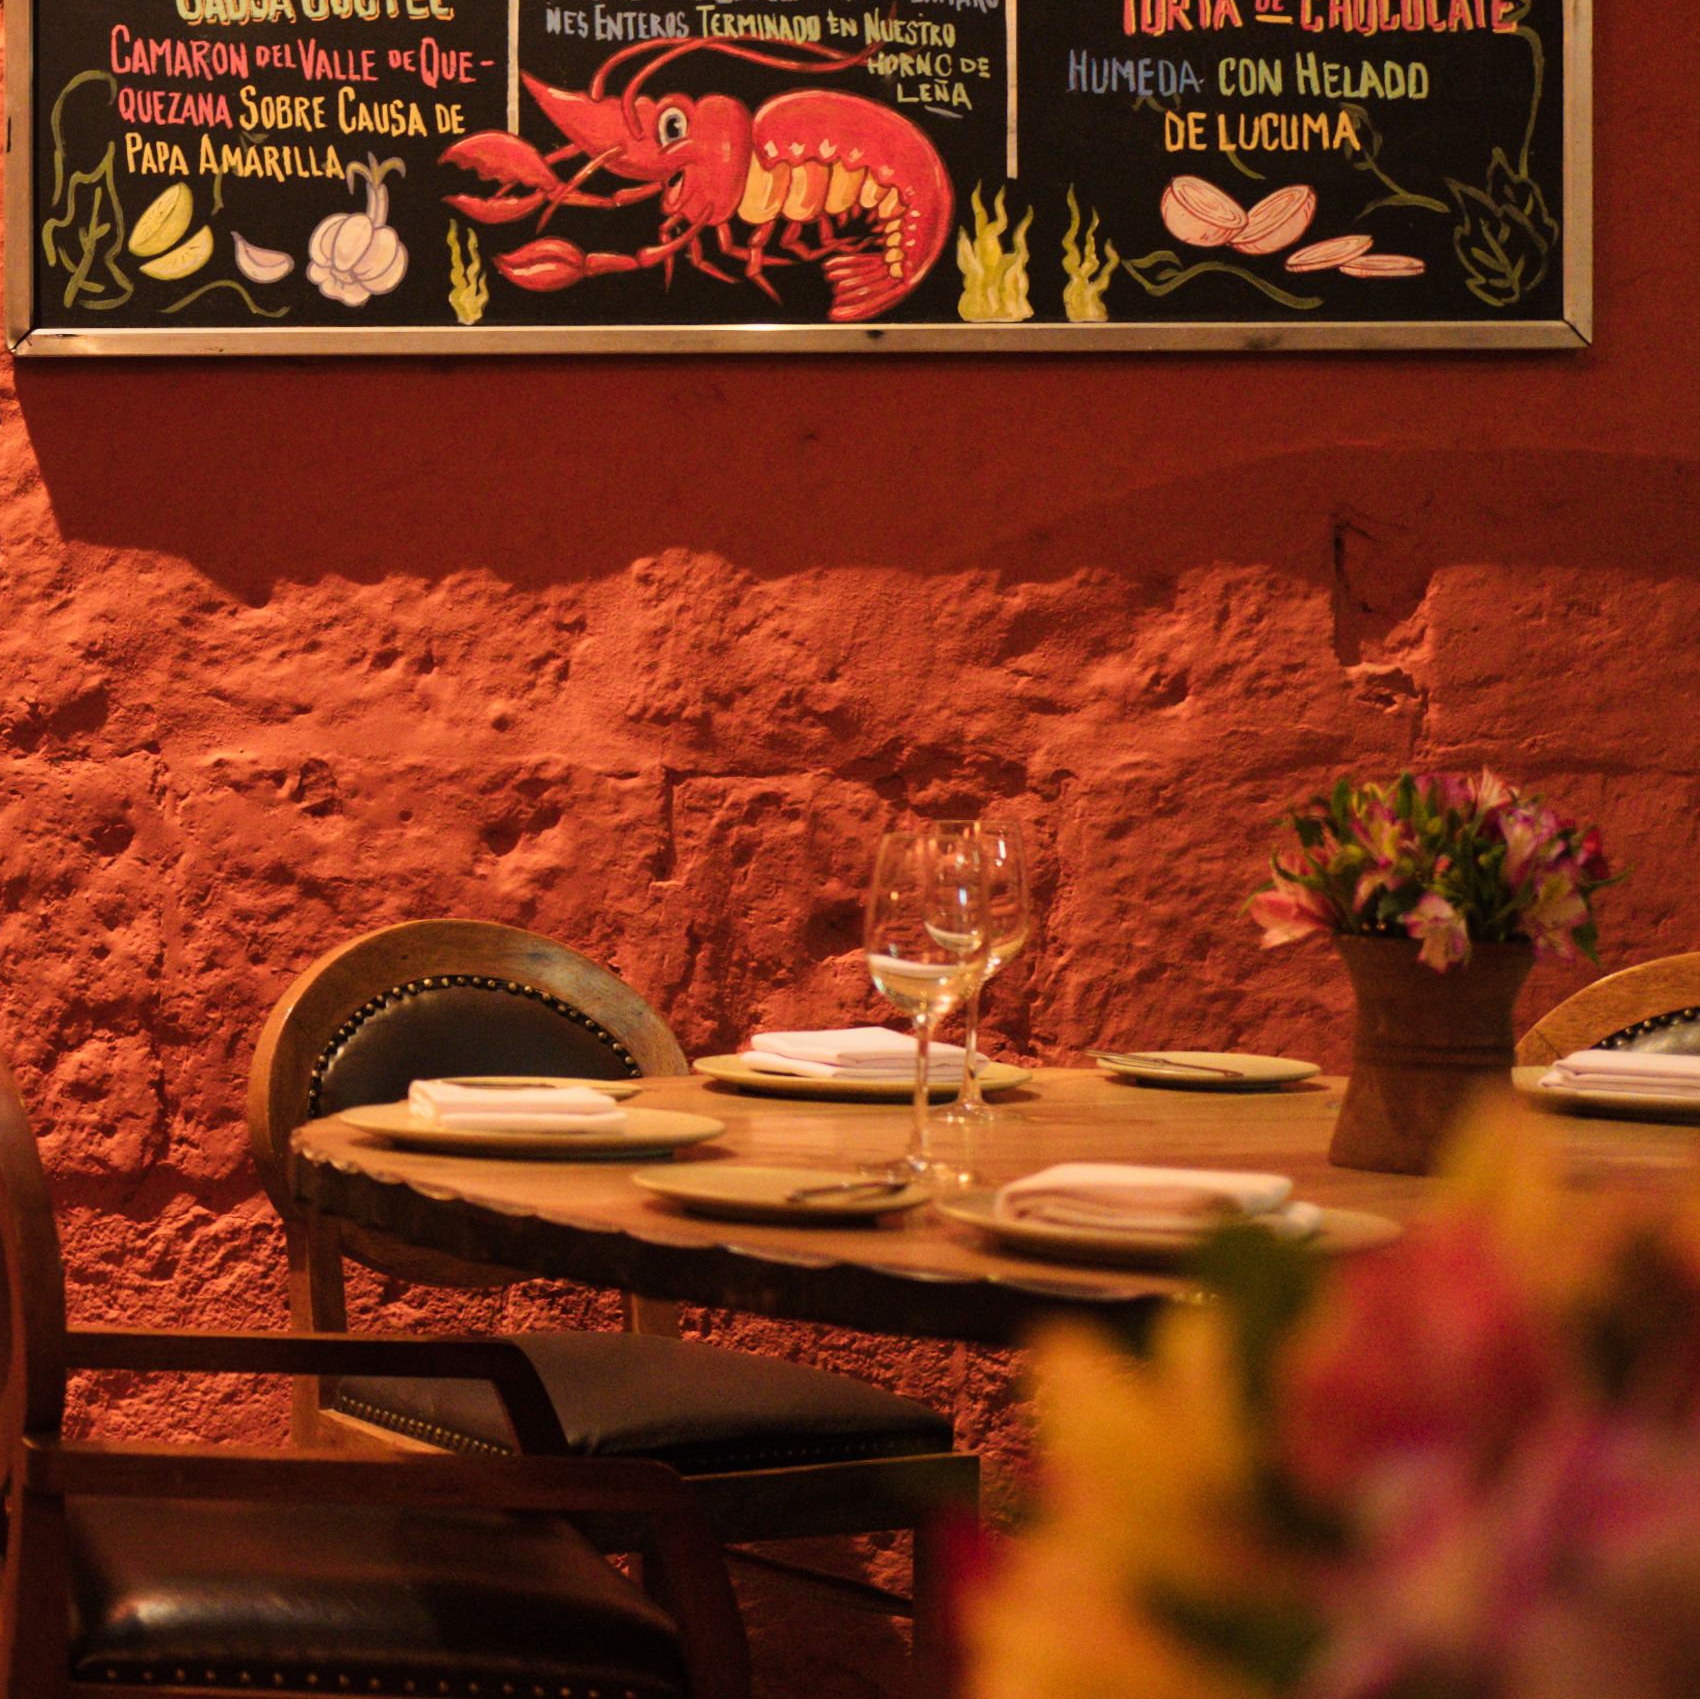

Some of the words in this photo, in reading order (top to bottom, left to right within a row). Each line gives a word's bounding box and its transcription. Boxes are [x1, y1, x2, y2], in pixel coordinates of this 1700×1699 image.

[546, 6, 589, 35] NES
[594, 5, 690, 42] ENTEROS
[696, 4, 821, 42] TERMINADO
[827, 9, 858, 34] EN
[863, 8, 956, 49] NUESTRO
[110, 25, 249, 81] CAMARON
[256, 43, 297, 71] DEL
[298, 37, 375, 81] VALLE
[388, 49, 415, 71] DE
[420, 37, 495, 88] QUE-
[960, 58, 991, 78] DE
[1066, 49, 1202, 98] HUMEDA
[1218, 57, 1284, 96] CON
[1295, 51, 1430, 101] HELADO
[118, 89, 234, 128] QUEZANA
[239, 84, 326, 131] SOBRE
[337, 86, 426, 137] CAUSA
[435, 102, 465, 135] DE
[897, 78, 972, 110] LEÑA
[1164, 111, 1207, 152] DE
[1218, 110, 1361, 152] LUCUMA
[125, 131, 189, 176] PAPA
[199, 133, 345, 182] AMARILLA
